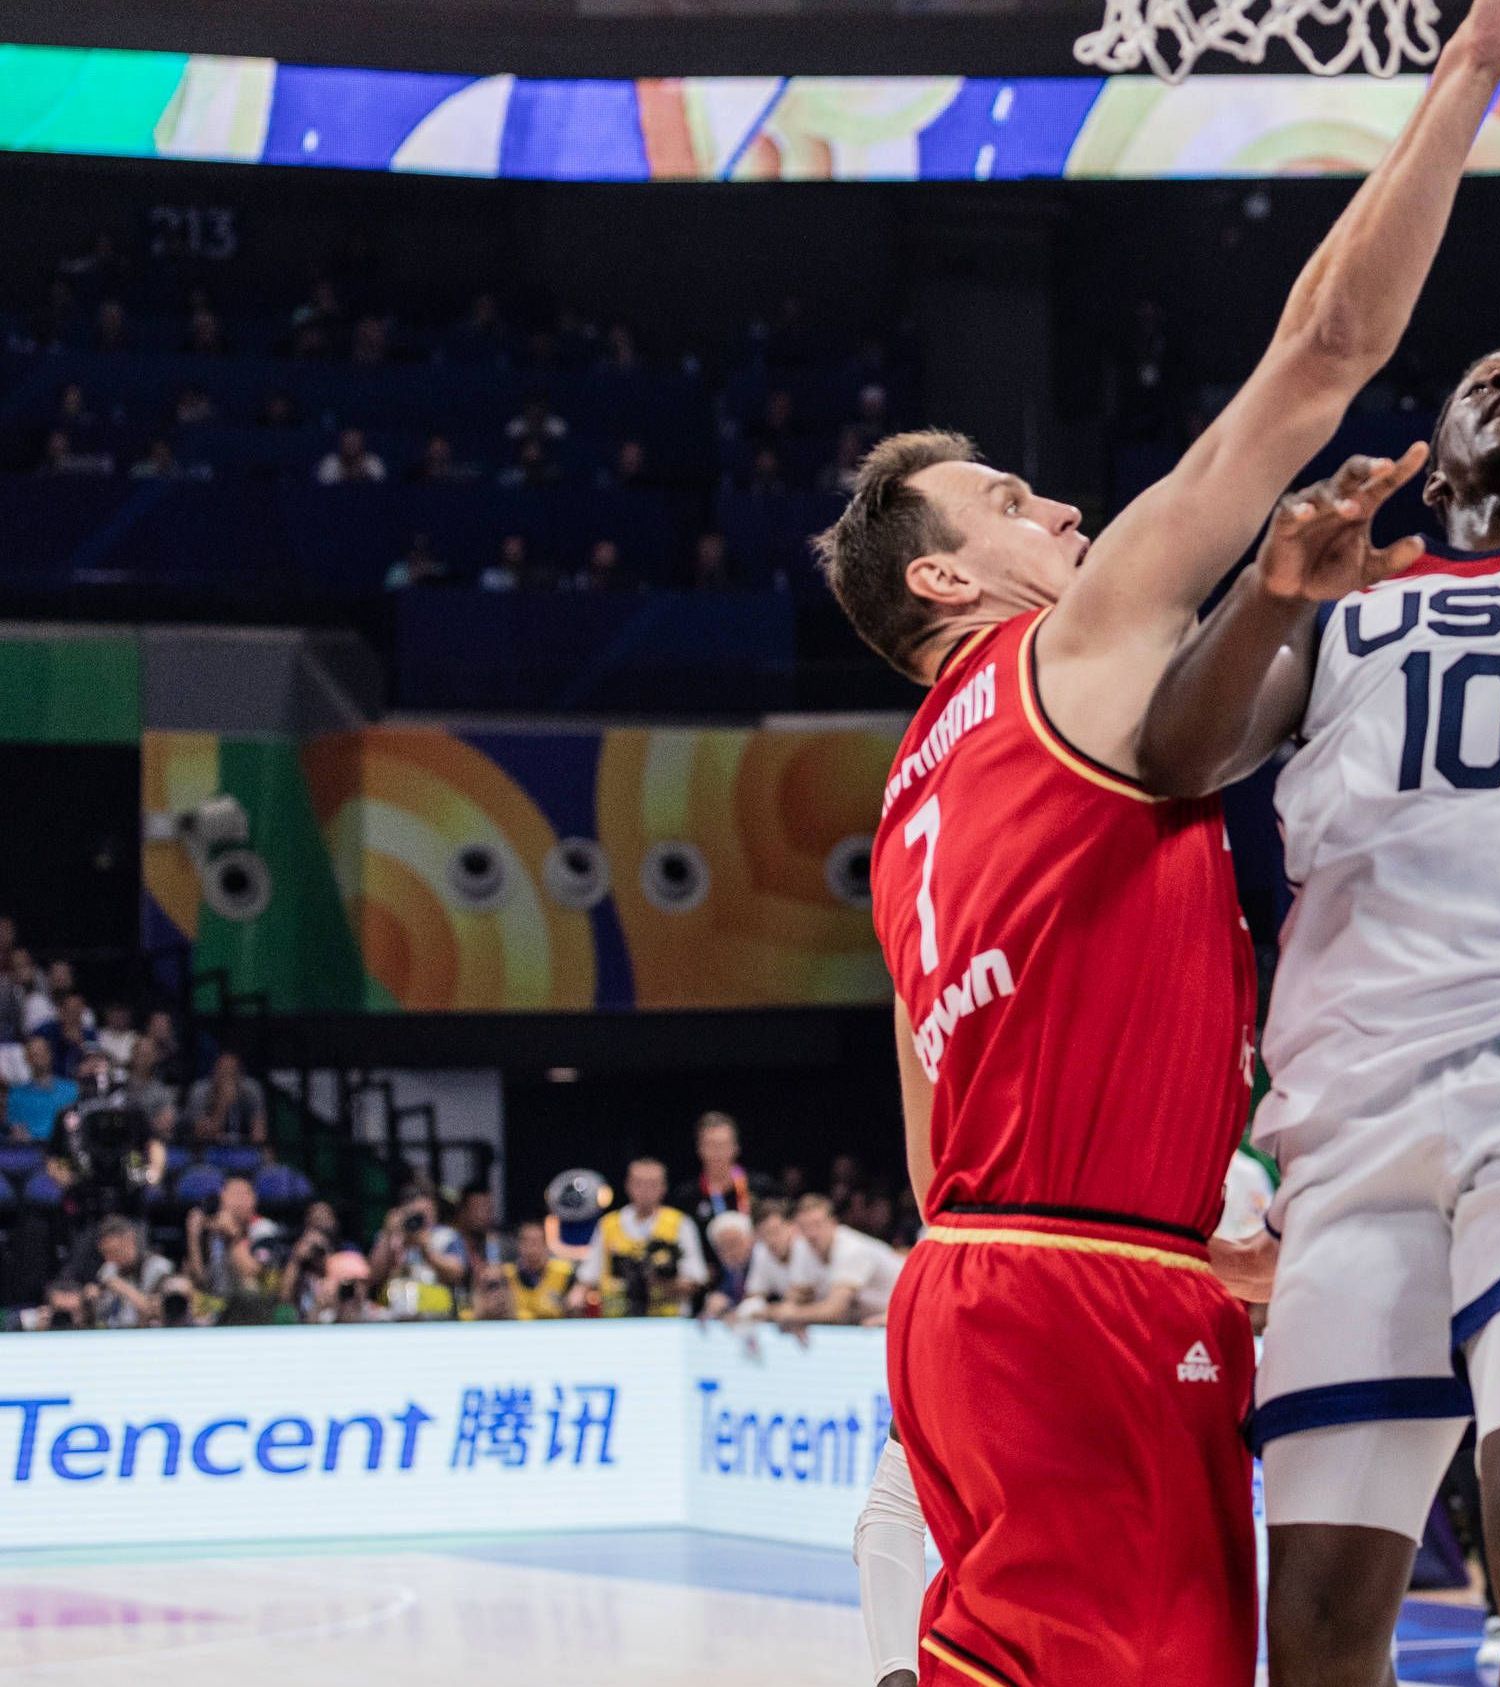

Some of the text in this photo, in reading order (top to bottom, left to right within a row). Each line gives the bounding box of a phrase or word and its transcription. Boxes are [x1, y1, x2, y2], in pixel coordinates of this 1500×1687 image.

[149, 205, 238, 257] 213
[903, 793, 941, 977] 7
[0, 1378, 621, 1483] Tencent 腾讯
[696, 1378, 860, 1486] Tencent
